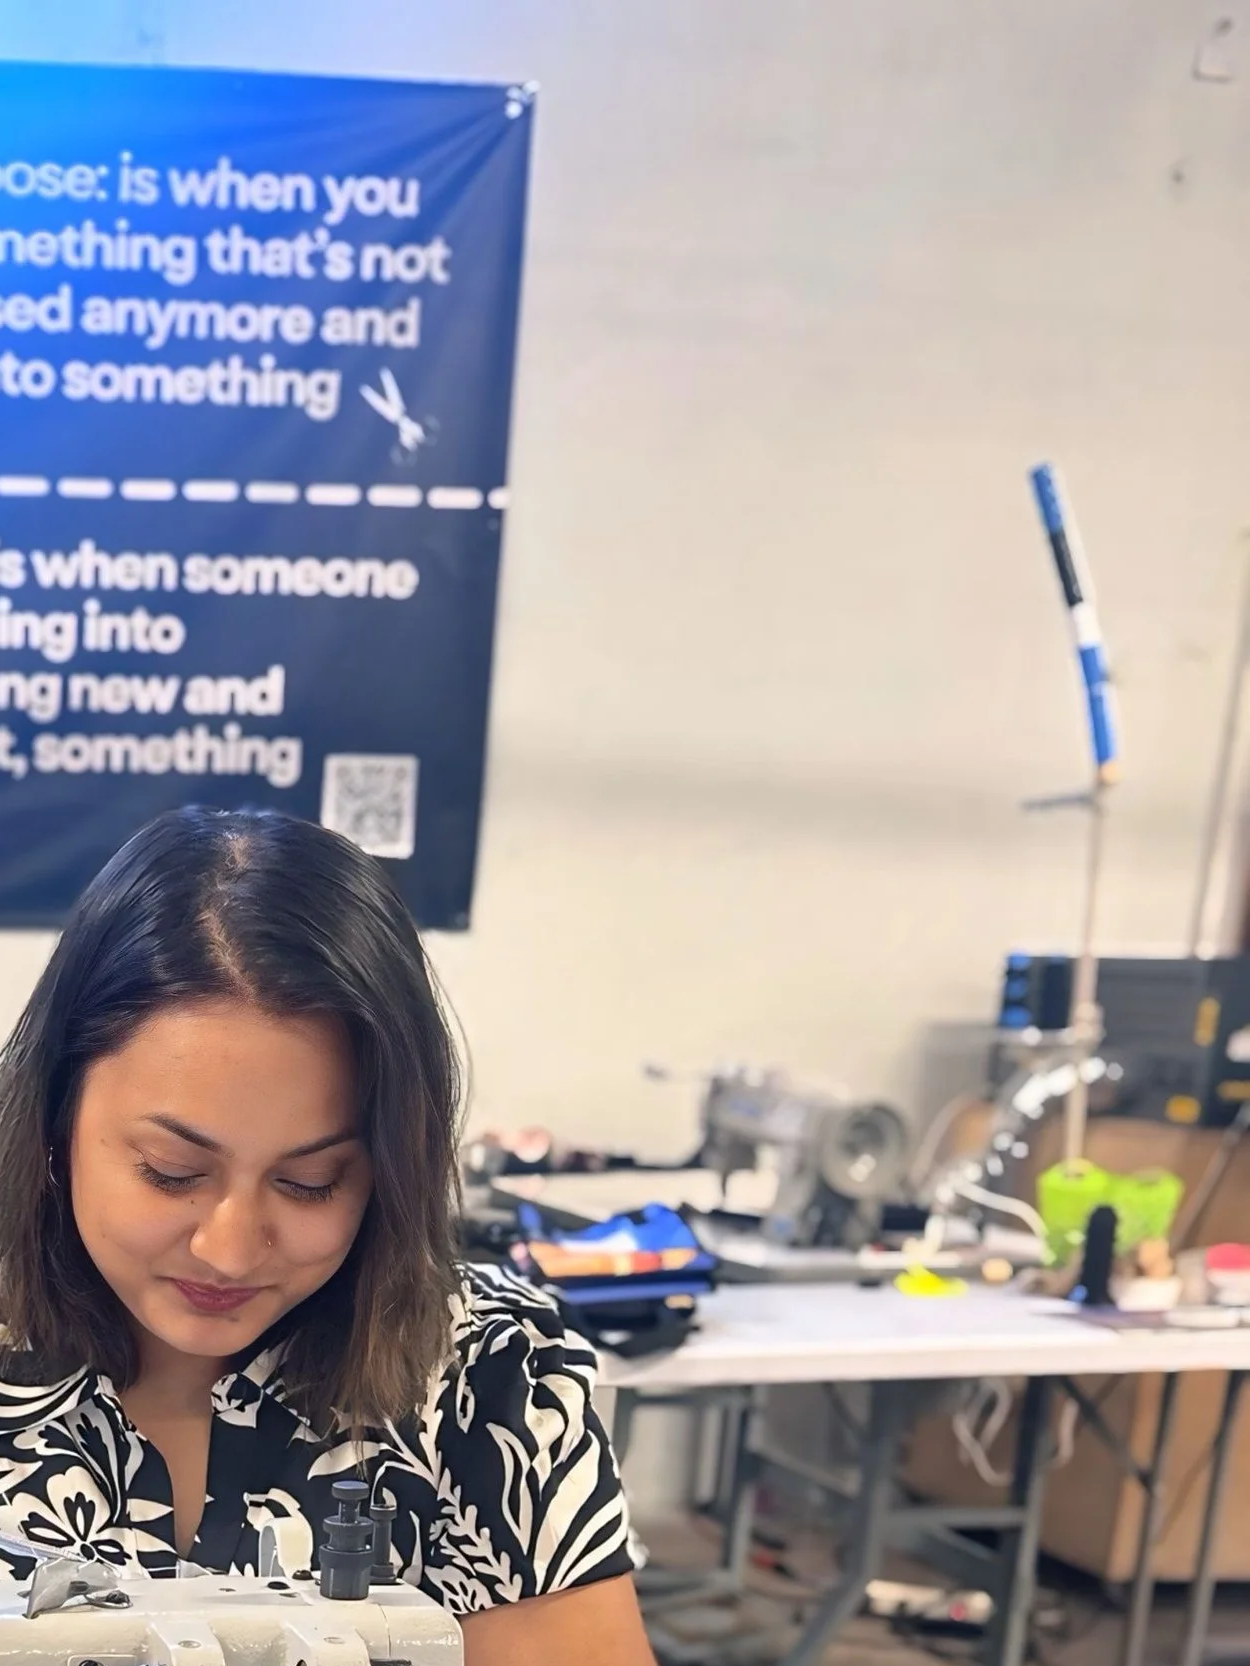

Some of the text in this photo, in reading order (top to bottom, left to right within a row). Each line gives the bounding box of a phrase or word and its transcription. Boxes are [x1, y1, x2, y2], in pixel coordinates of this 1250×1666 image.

[119, 150, 158, 204] is
[167, 157, 313, 213] when
[323, 174, 420, 225] you
[204, 227, 352, 280] that's
[361, 236, 449, 284] not
[81, 296, 314, 349] anymore
[321, 299, 420, 347] and
[61, 353, 341, 421] something
[31, 540, 179, 592] when
[182, 553, 420, 600] someone
[82, 599, 185, 655] into
[69, 672, 181, 714] new
[184, 665, 285, 716] and
[32, 722, 303, 788] something
